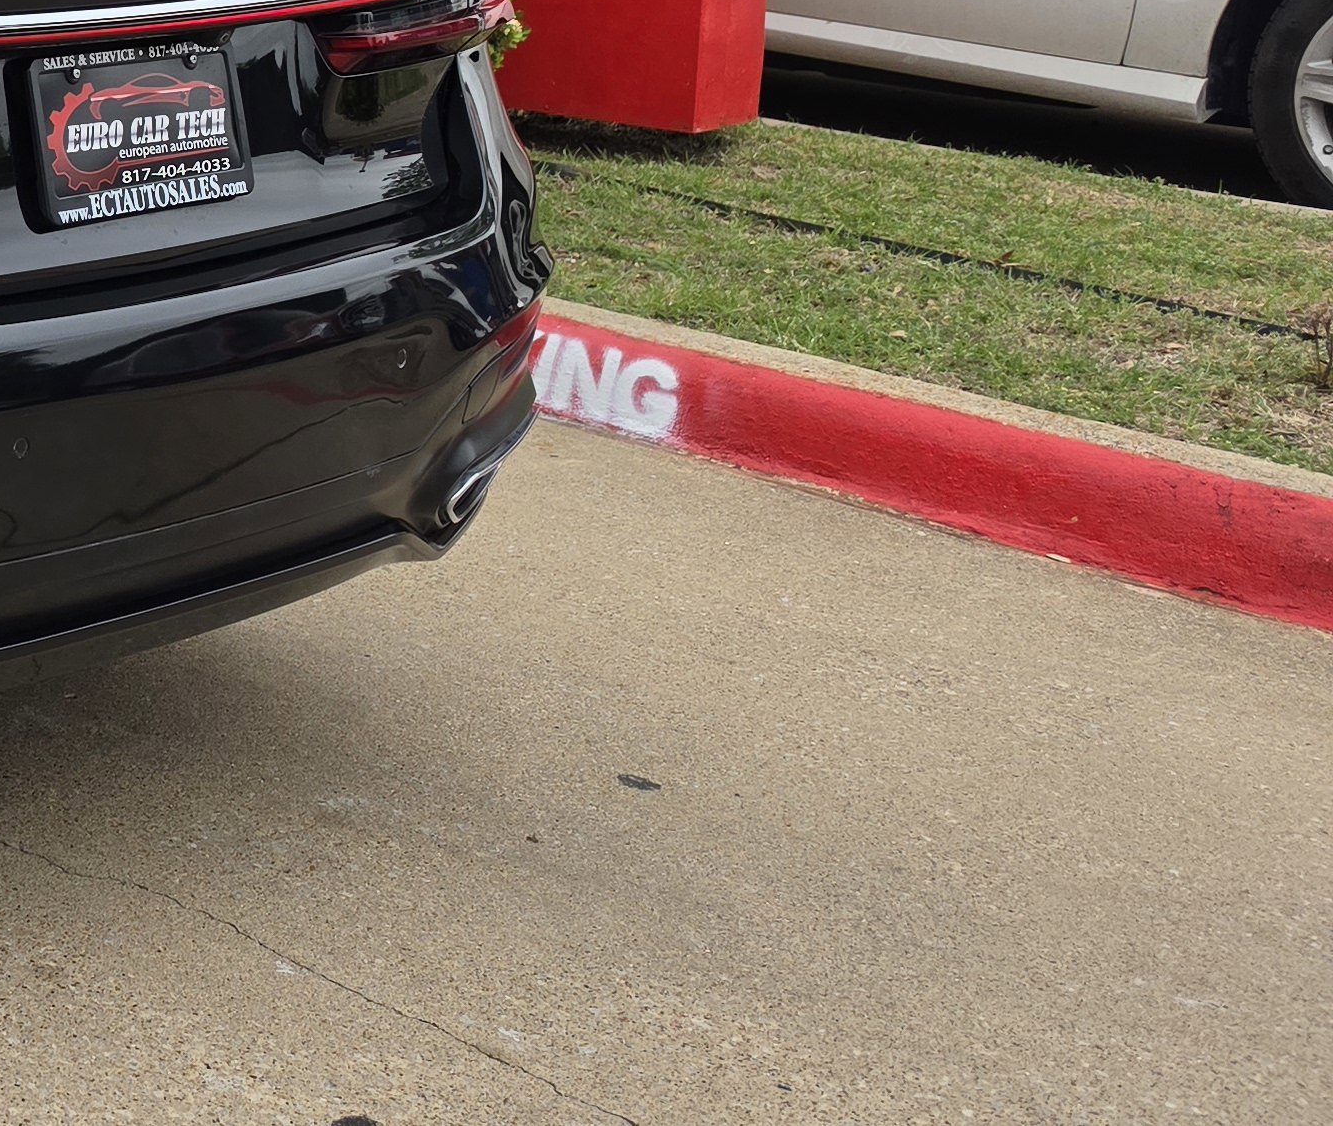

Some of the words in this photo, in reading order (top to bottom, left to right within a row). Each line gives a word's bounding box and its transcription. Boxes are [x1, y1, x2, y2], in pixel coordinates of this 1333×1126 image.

[43, 55, 75, 70] SALES
[78, 55, 87, 66] &
[89, 48, 136, 65] SERVICE
[66, 123, 124, 153] EURO
[130, 113, 170, 145] CAR
[175, 108, 226, 143] TECH
[119, 143, 169, 160] european
[170, 135, 229, 153] automotive
[121, 157, 231, 184] 817-404-4033
[58, 174, 248, 224] www.ECTAUTOSALES.com
